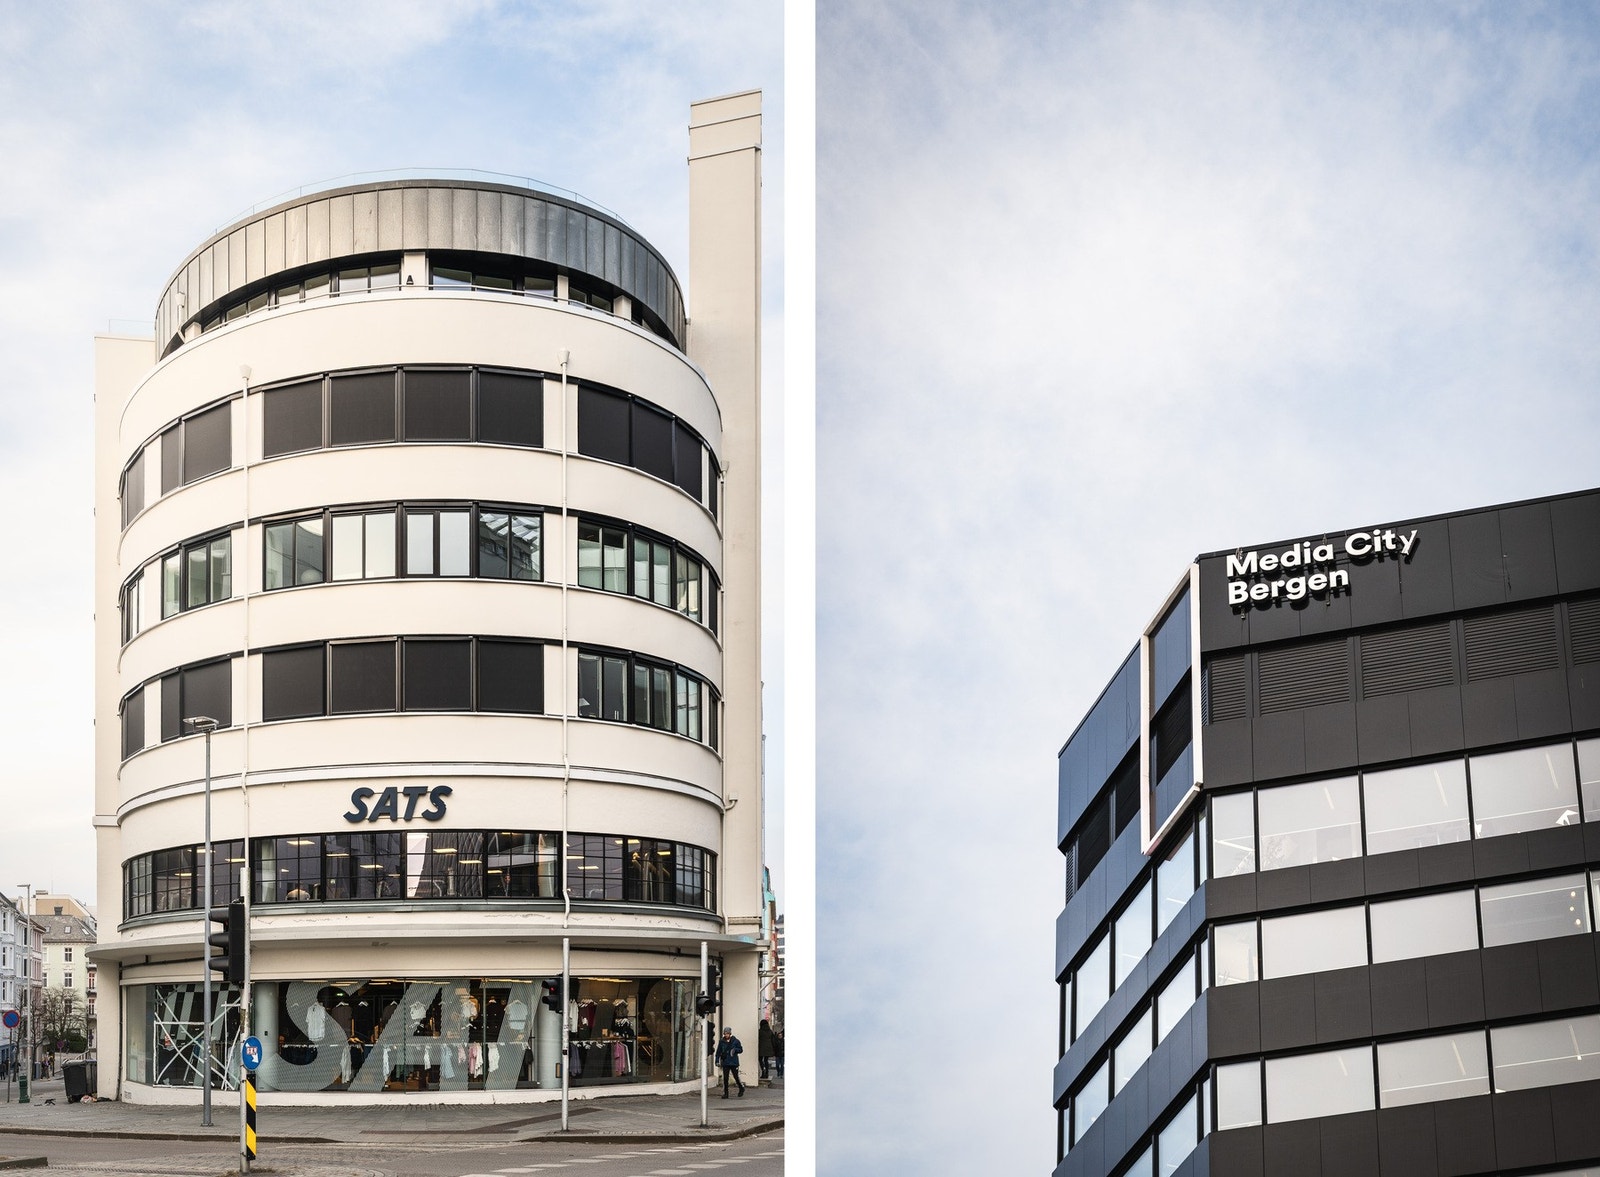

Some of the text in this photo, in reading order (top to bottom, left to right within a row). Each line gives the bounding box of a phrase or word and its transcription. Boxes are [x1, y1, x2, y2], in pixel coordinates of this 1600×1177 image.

[1226, 529, 1418, 577] Media City
[1228, 569, 1349, 605] Bergen
[343, 785, 453, 823] SATS
